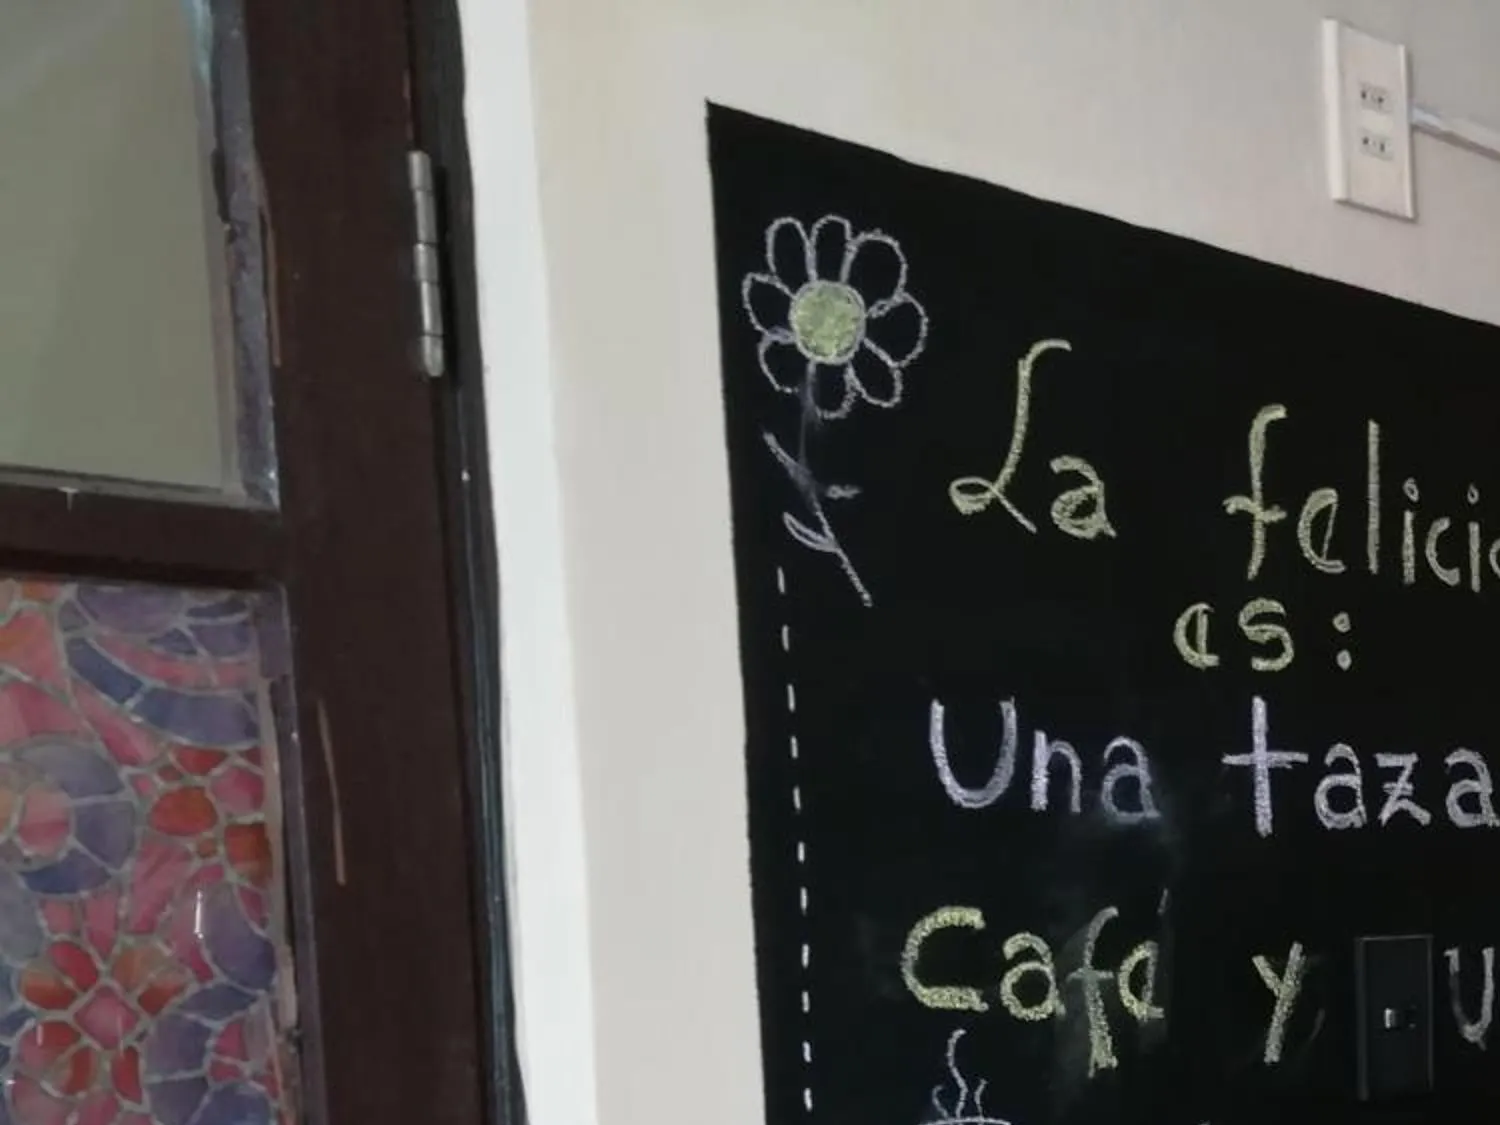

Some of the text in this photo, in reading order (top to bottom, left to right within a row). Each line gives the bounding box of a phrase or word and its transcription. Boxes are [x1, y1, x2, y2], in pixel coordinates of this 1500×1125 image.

[948, 338, 1117, 538] La
[927, 698, 1158, 822] Una
[1222, 695, 1500, 837] taza
[1250, 941, 1307, 1064] y
